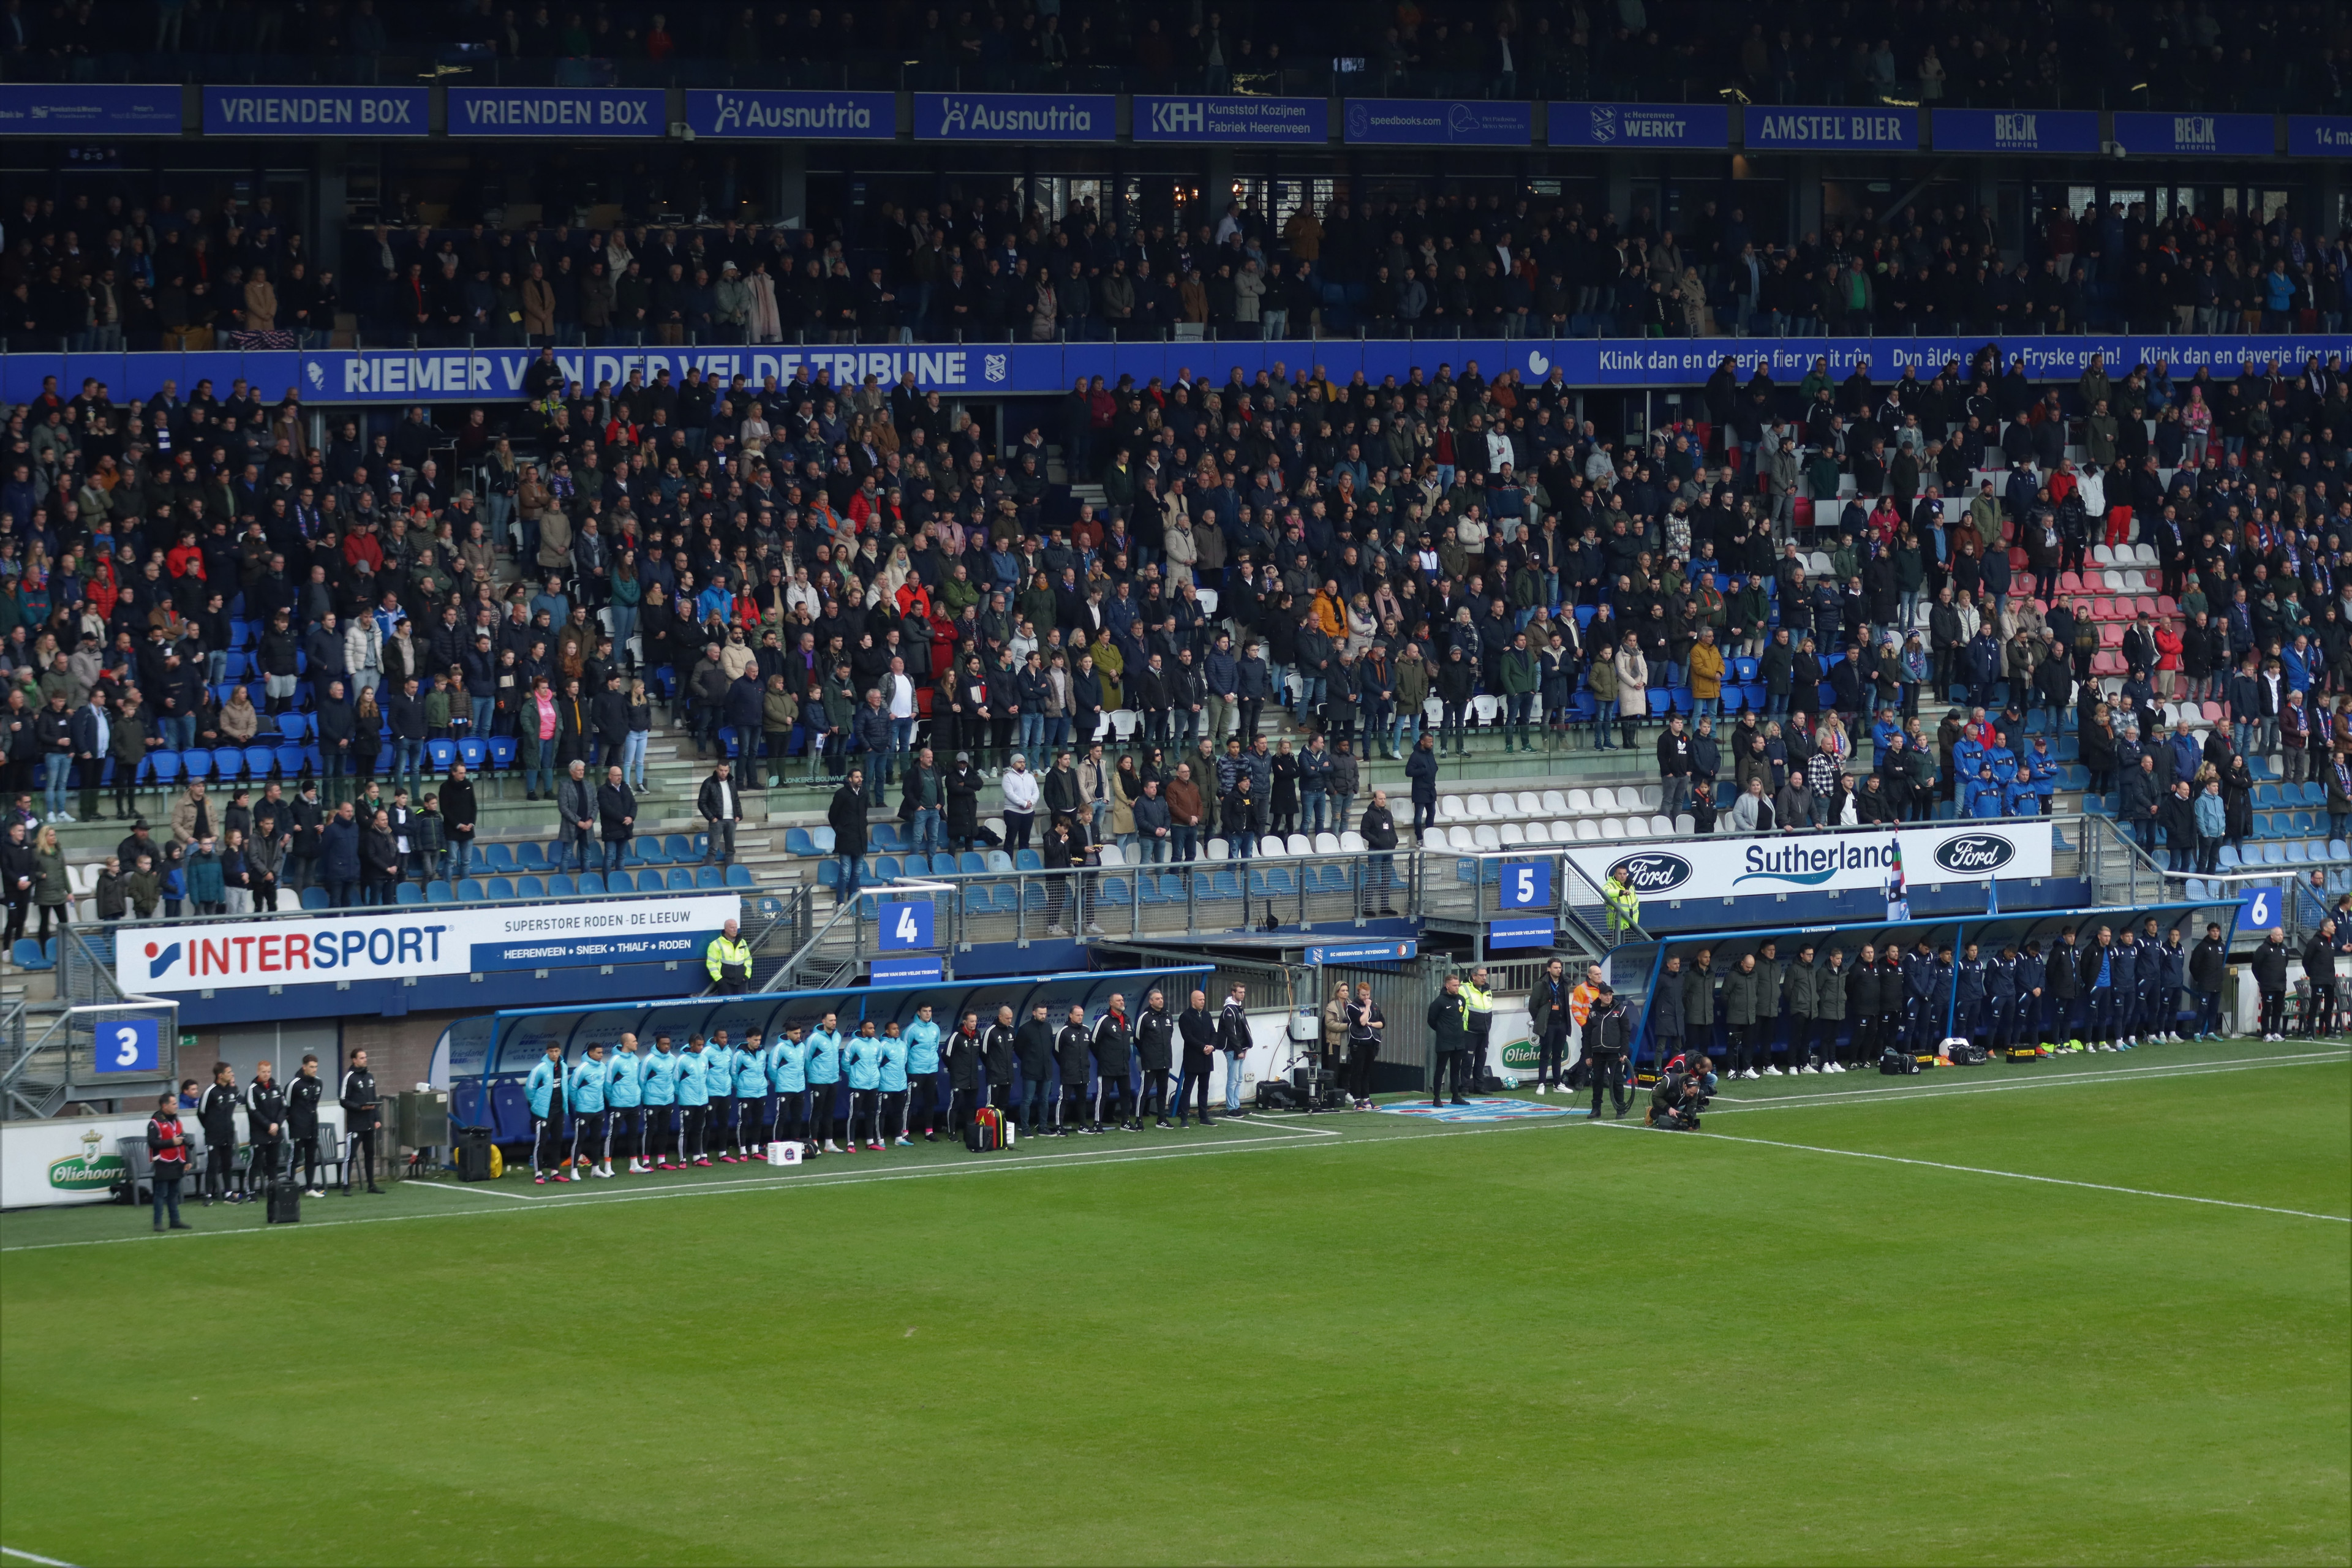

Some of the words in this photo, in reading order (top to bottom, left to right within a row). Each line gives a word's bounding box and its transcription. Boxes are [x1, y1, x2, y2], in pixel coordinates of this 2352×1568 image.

[221, 98, 352, 124] VRIENDEN
[361, 99, 411, 124] BOX
[465, 100, 592, 124] VRIENDEN
[599, 100, 648, 125] BOX
[746, 100, 871, 129] Ausnutria
[972, 104, 1091, 132] Ausnutria
[1152, 102, 1204, 133] KFH
[1208, 103, 1258, 116] Kunststof
[1261, 104, 1306, 118] Kozijnen
[1370, 115, 1441, 126] speedbooks.com
[1208, 121, 1246, 133] Fabriek
[1249, 121, 1311, 134] Heerenveen
[1624, 120, 1686, 138] WERKT
[1760, 115, 1845, 140] AMSTEL
[1852, 117, 1903, 141] BIER
[2315, 127, 2332, 145] 14
[1996, 141, 2038, 149] catering
[1599, 350, 1644, 370] Klink
[1648, 350, 1678, 369] dan
[1683, 355, 1702, 369] en
[1773, 349, 1802, 368] fier
[1829, 349, 1840, 368] it
[2023, 347, 2075, 370] Fryske
[2140, 346, 2179, 364] Klink
[2183, 346, 2211, 364] dan
[2215, 350, 2233, 364] en
[2237, 346, 2292, 368] daverje
[344, 355, 493, 393] RIEMER
[500, 355, 584, 391] VN
[594, 355, 670, 389] DER
[810, 352, 967, 386] TRIBUNE
[1745, 839, 1896, 873] Sutherland
[1949, 839, 1999, 869] Ford
[1517, 868, 1534, 903] 5
[1626, 859, 1676, 886] Ford
[505, 916, 581, 932] SUPERSTORE
[584, 914, 624, 927] RODEN
[650, 911, 692, 924] LEEUW
[2252, 892, 2268, 925] 6
[895, 907, 918, 943] 4
[189, 924, 448, 978] INTERSPORT
[504, 946, 566, 960] HEERENVEEN
[576, 944, 608, 956] SNEEK
[617, 941, 649, 953] THIALF
[658, 939, 692, 951] RODEN
[115, 1027, 138, 1066] 3
